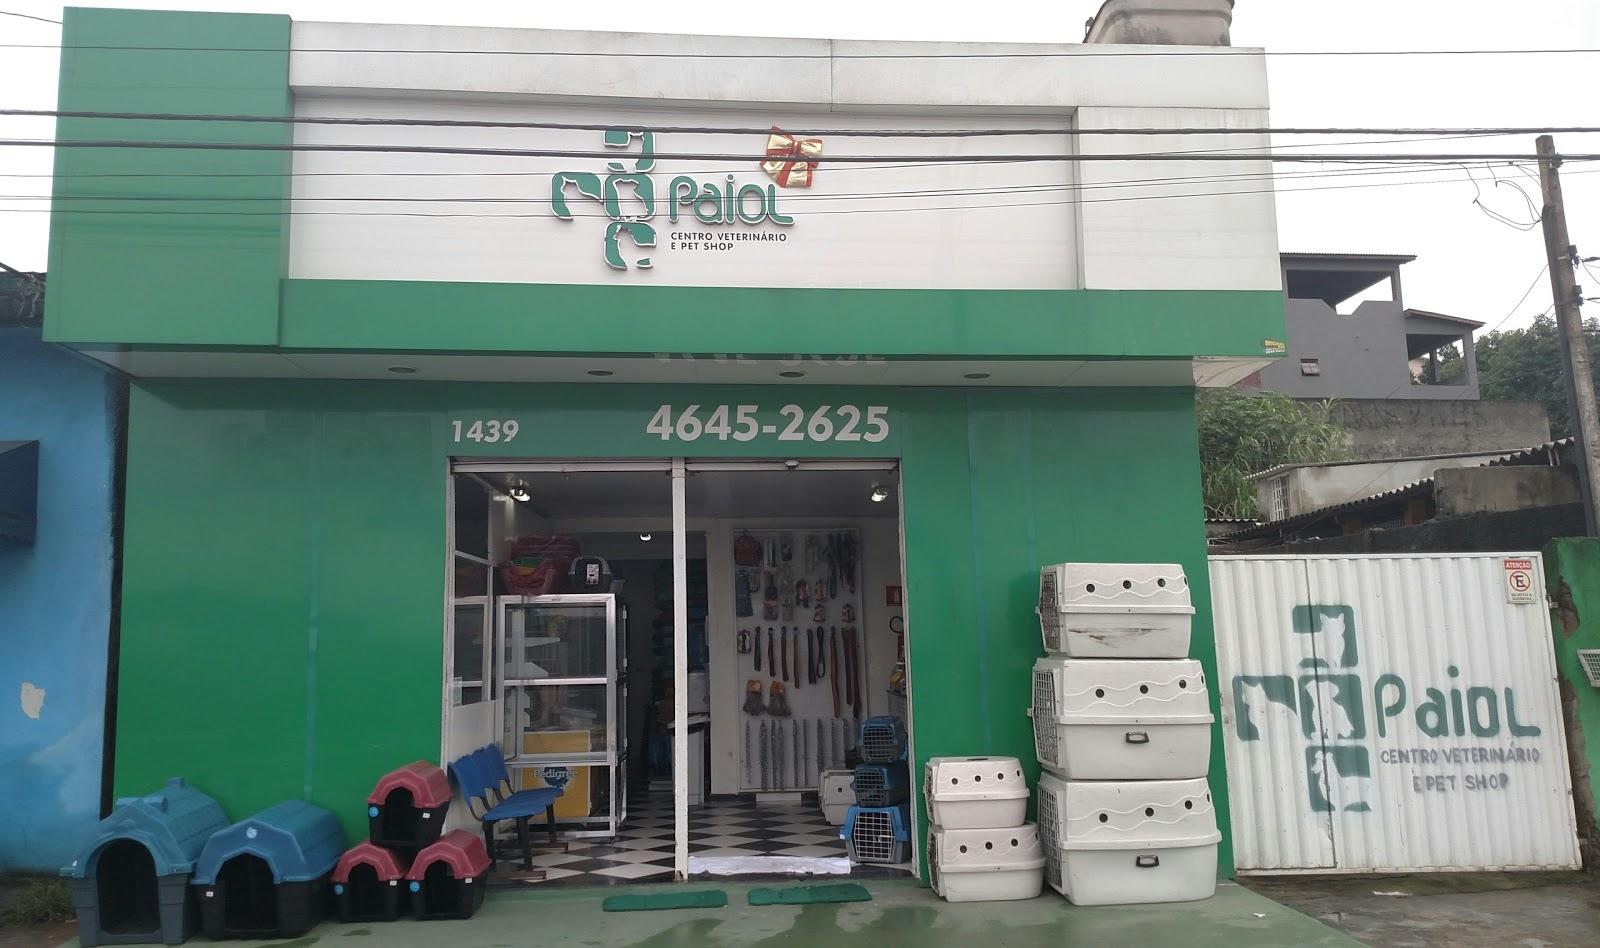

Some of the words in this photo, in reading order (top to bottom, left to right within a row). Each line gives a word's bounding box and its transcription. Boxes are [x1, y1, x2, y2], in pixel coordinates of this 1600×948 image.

[670, 231, 713, 241] CENTRO
[717, 230, 787, 242] VETERINÁRIO
[670, 242, 676, 250] E
[681, 242, 699, 250] PET
[703, 242, 734, 251] SHOP
[451, 420, 519, 443] 1439
[646, 404, 889, 443] 4645-2625
[1506, 561, 1531, 569] ATENÇÃO
[1380, 748, 1438, 764] CENTRO
[1442, 740, 1540, 764] VETERINÁRIO
[533, 769, 577, 780] Pedigree
[1412, 775, 1422, 793] E
[1425, 775, 1456, 791] PET
[1465, 773, 1509, 791] SHOP
